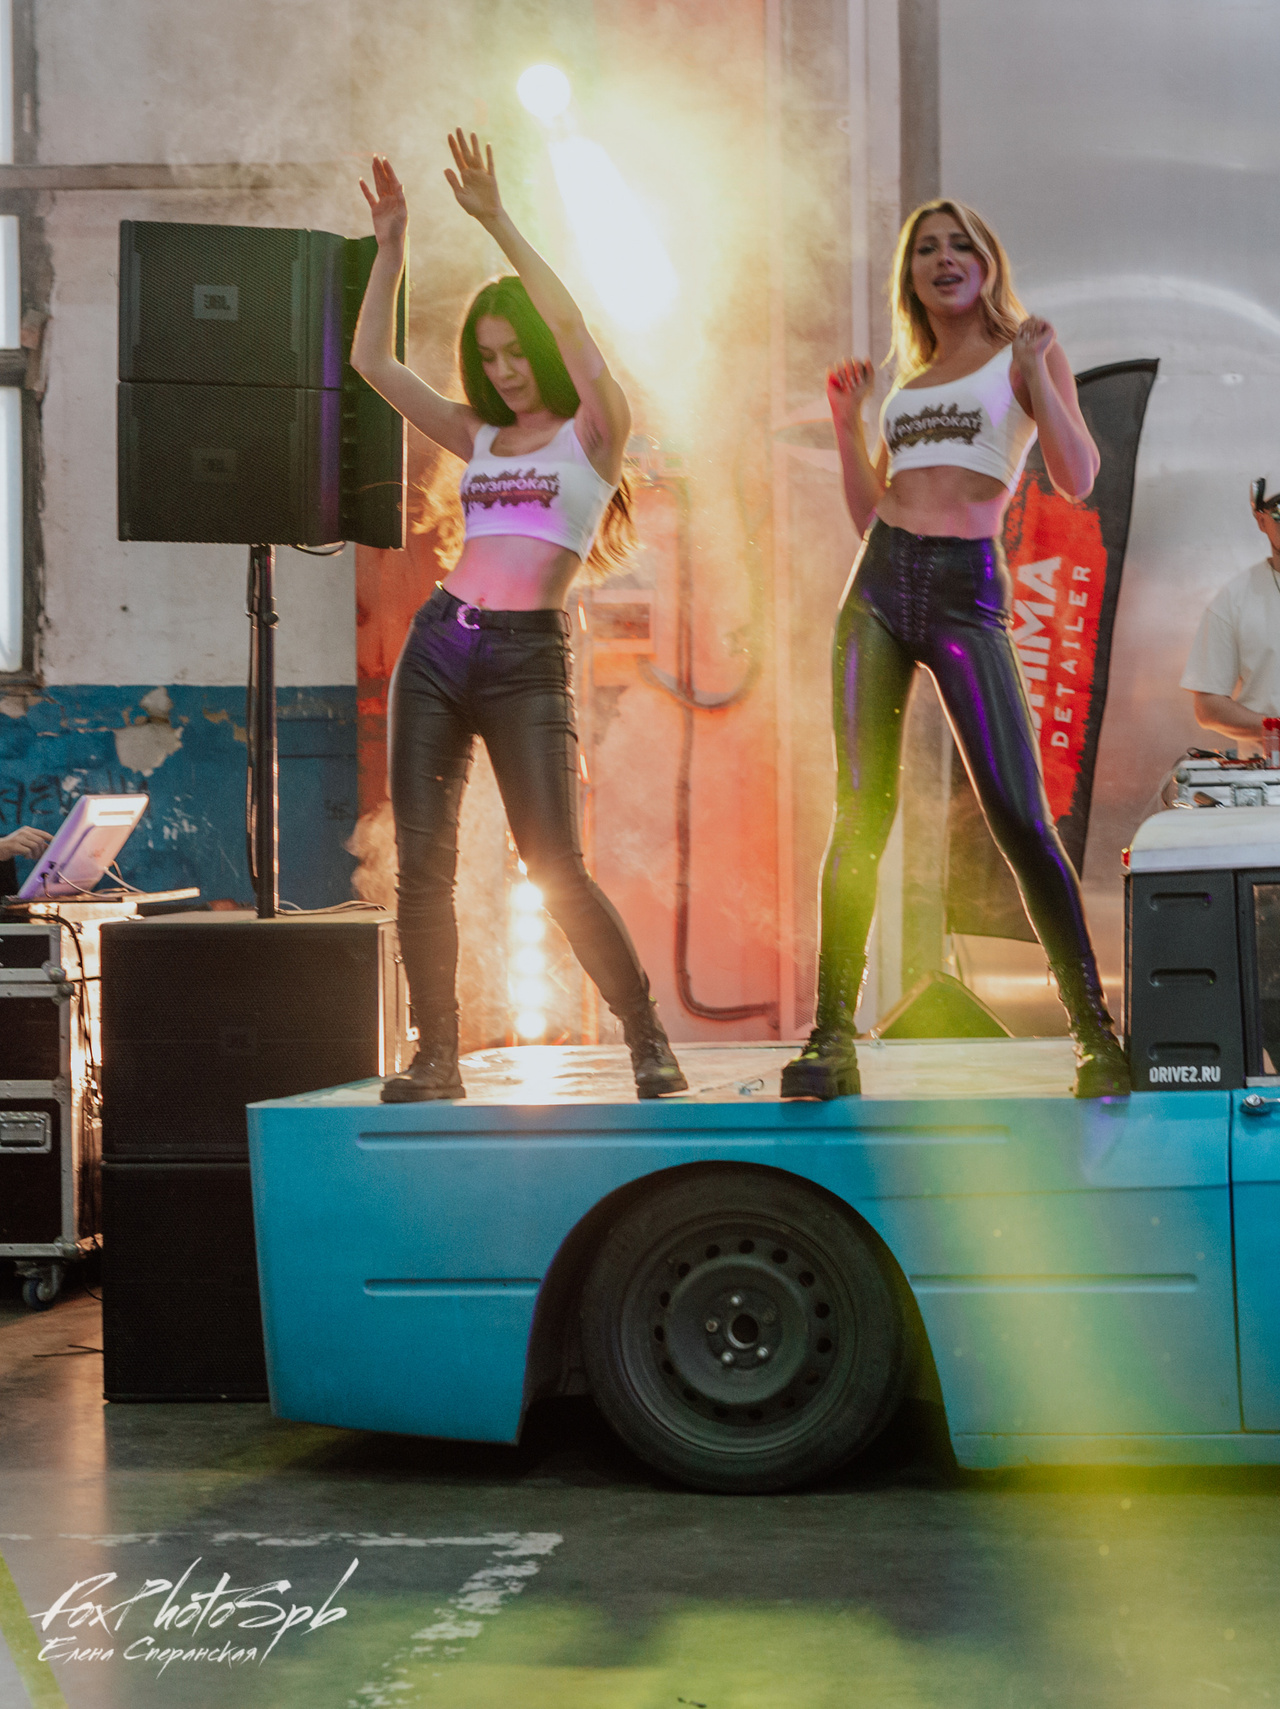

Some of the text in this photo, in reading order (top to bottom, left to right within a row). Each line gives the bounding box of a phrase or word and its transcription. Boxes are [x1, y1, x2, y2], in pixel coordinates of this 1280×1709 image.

[203, 294, 231, 310] JBL
[1012, 556, 1062, 741] HIMA
[1051, 565, 1092, 749] DETAILER
[1149, 1066, 1221, 1083] DRIVE2.RU
